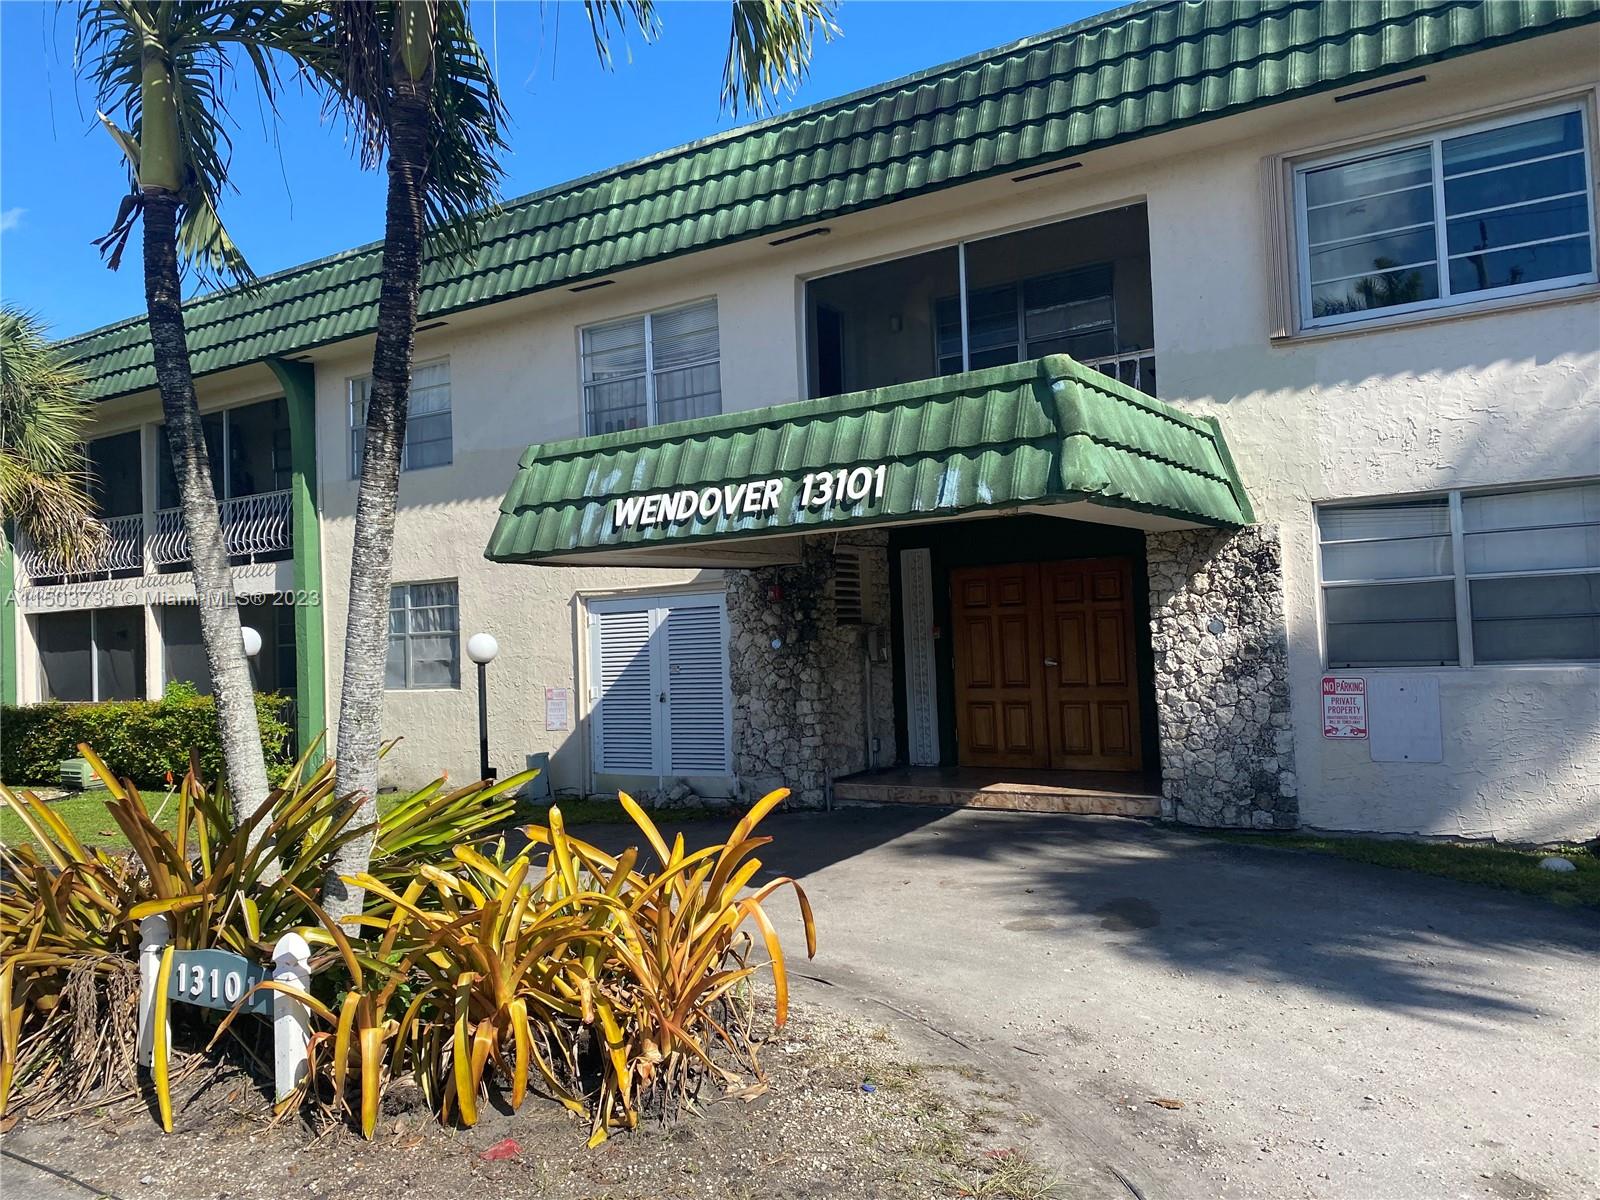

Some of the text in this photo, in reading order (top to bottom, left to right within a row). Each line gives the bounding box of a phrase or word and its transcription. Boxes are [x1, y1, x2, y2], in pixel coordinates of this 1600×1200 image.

[614, 465, 887, 527] WENDOVER 13101
[1323, 681, 1335, 692] NO
[1335, 681, 1363, 692] PARKING
[1331, 697, 1357, 705] PRIVATE
[1328, 706, 1361, 714] PROPERTY
[177, 963, 255, 1006] 13101
